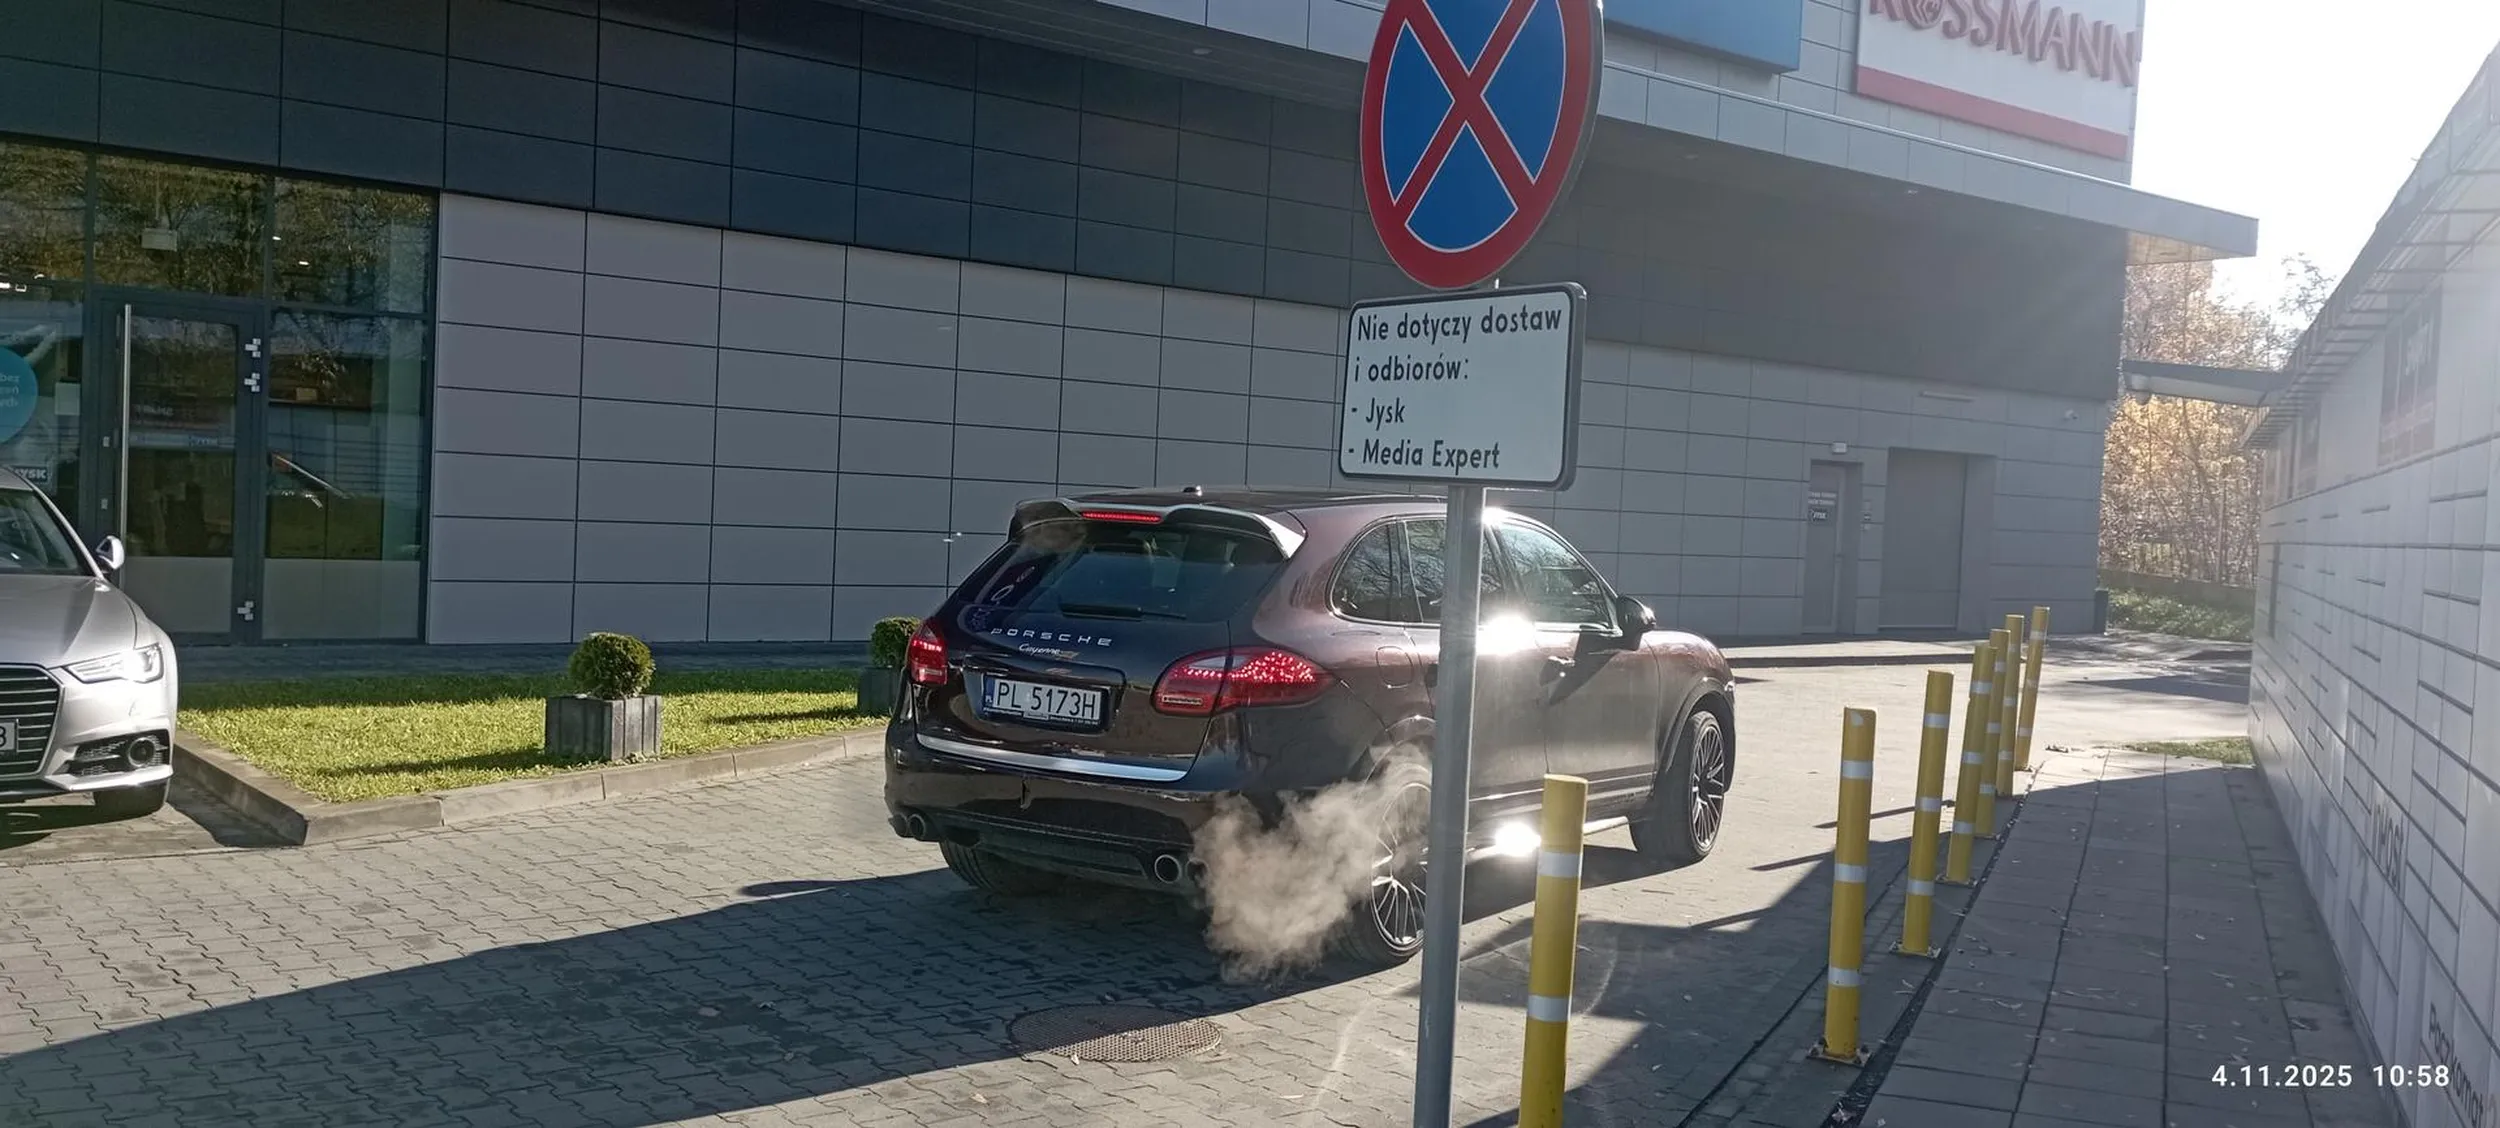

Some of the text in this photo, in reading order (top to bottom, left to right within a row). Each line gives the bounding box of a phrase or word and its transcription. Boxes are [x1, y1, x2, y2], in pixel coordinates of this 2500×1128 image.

[1357, 304, 1562, 345] Nie dotyczy dostaw
[1354, 352, 1469, 382] i odbiorów:
[1365, 397, 1406, 431] Jysk
[1362, 438, 1423, 466] Media
[1432, 439, 1500, 476] Expert
[990, 627, 1113, 647] PORSCHE
[1018, 643, 1061, 656] Cayenne
[996, 681, 1096, 719] PL 5173H
